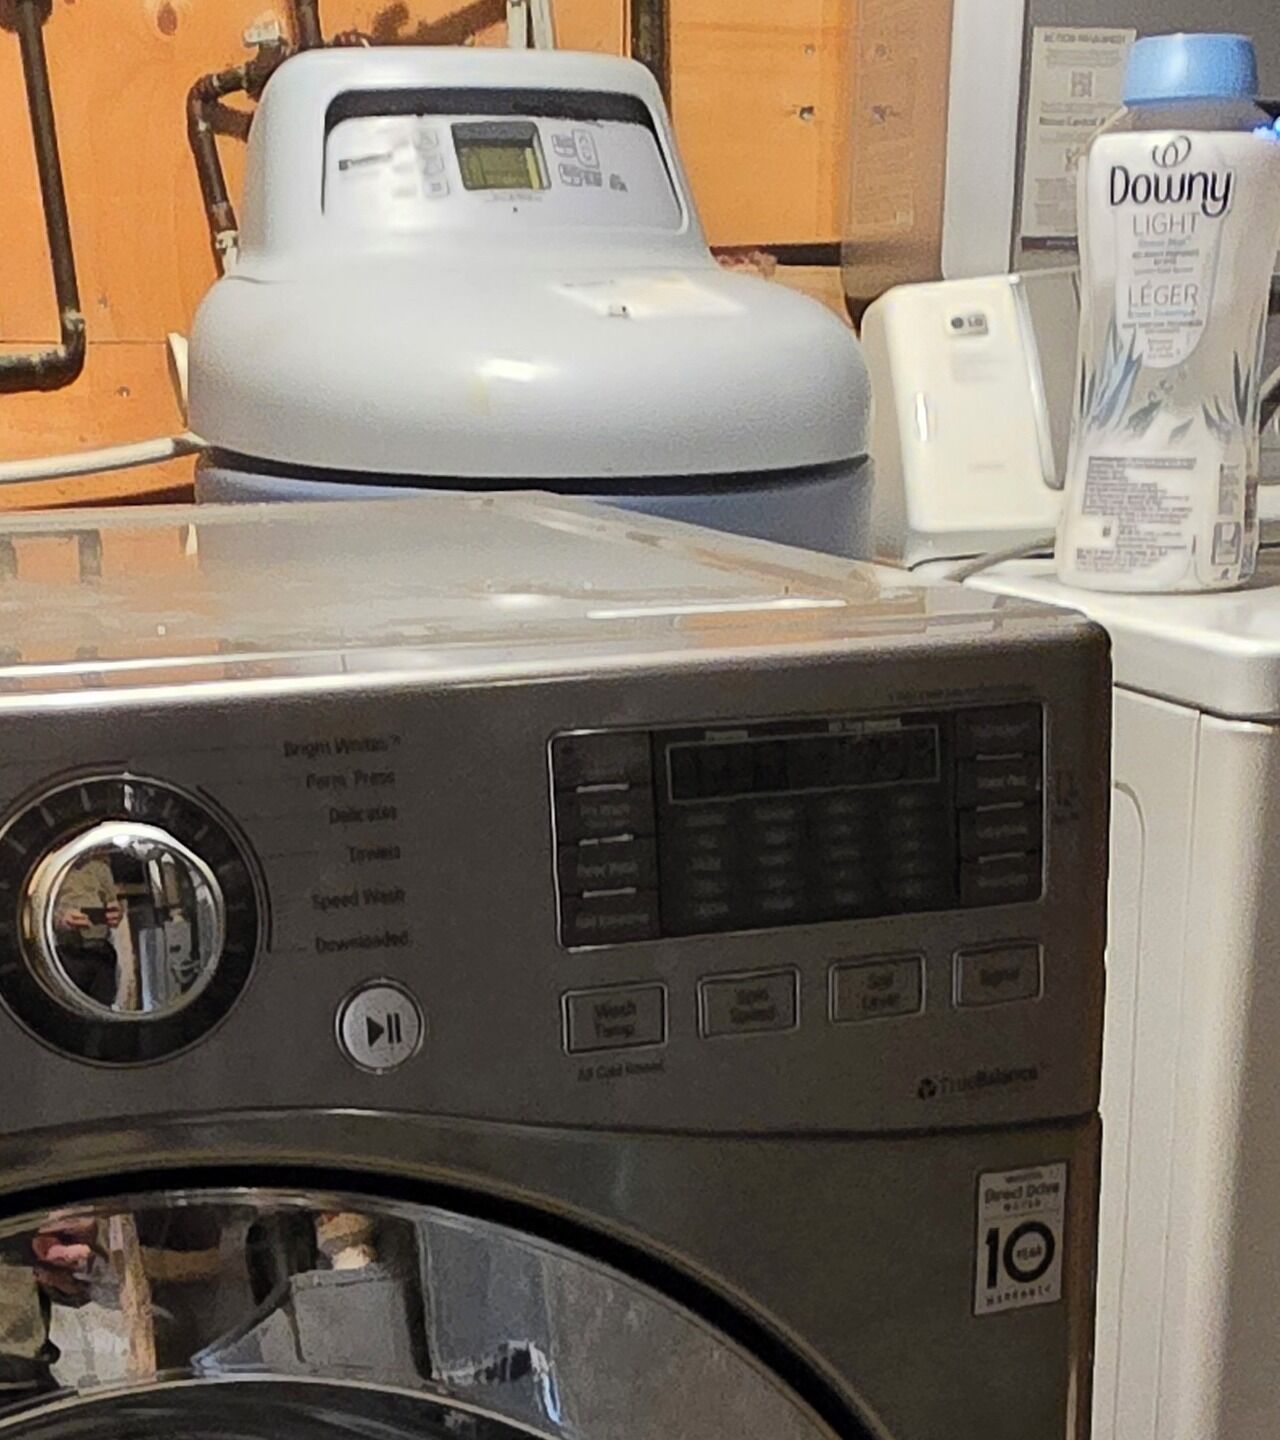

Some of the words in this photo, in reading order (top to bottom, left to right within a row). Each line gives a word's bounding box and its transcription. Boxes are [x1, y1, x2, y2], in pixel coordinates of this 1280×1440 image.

[1110, 166, 1232, 218] Downy
[1133, 212, 1201, 237] LIGHT
[1128, 280, 1199, 307] LÉGER
[985, 1220, 1056, 1290] 10
